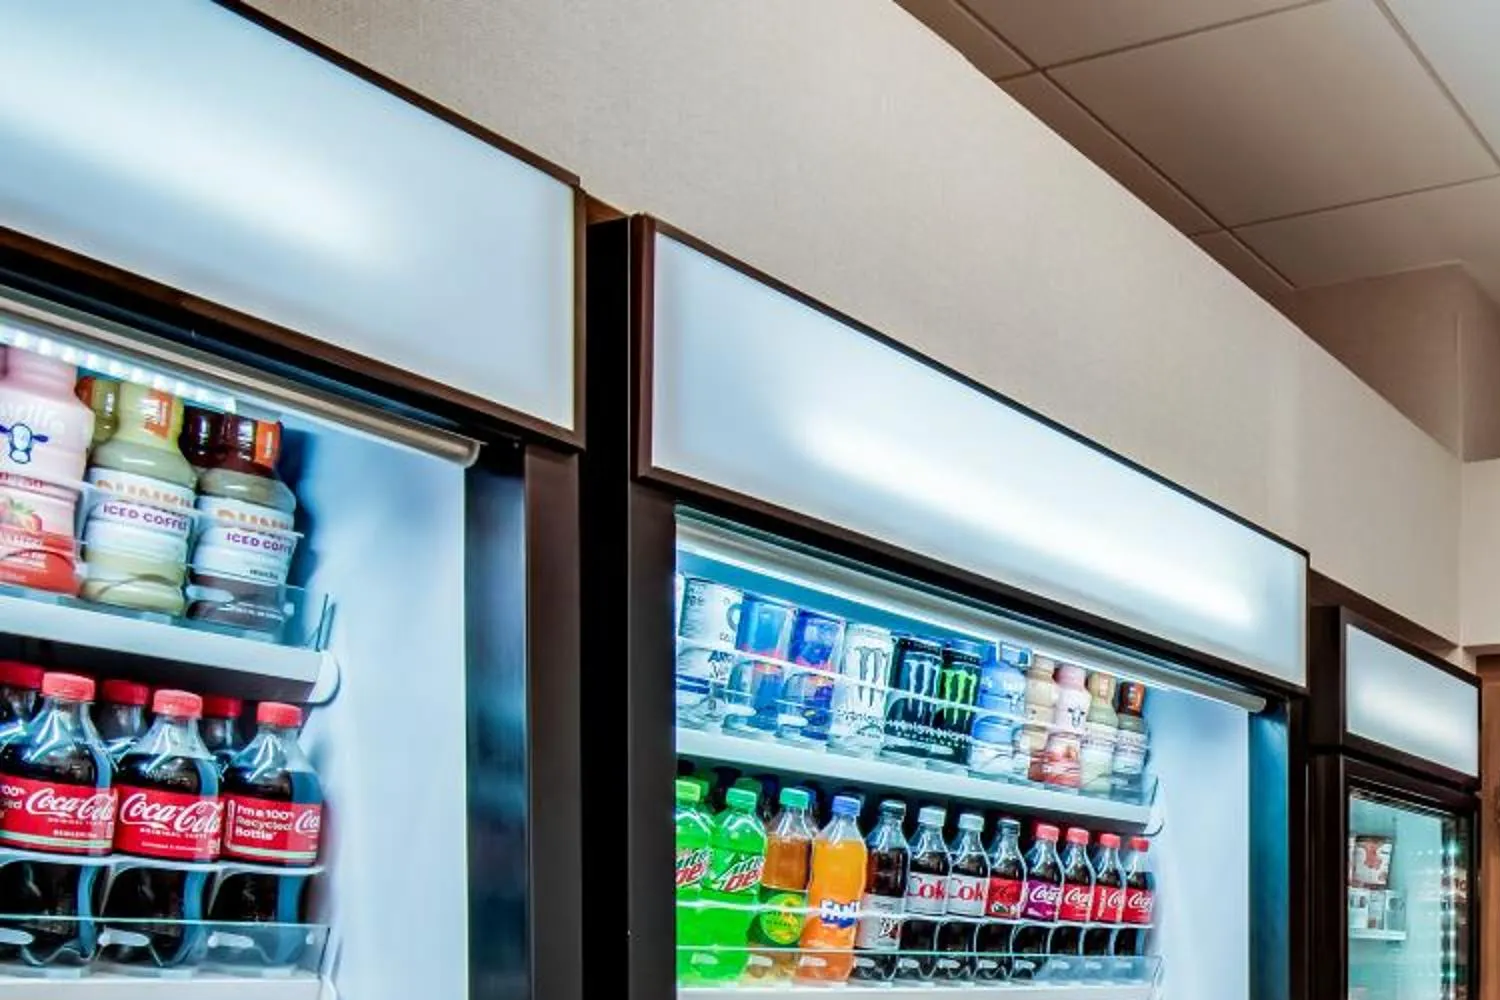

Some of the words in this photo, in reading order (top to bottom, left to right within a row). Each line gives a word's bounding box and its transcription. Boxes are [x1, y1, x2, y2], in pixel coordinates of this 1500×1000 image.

[103, 502, 139, 519] ICED
[226, 531, 259, 547] ICED
[907, 876, 945, 901] Cok
[950, 877, 983, 902] Cok
